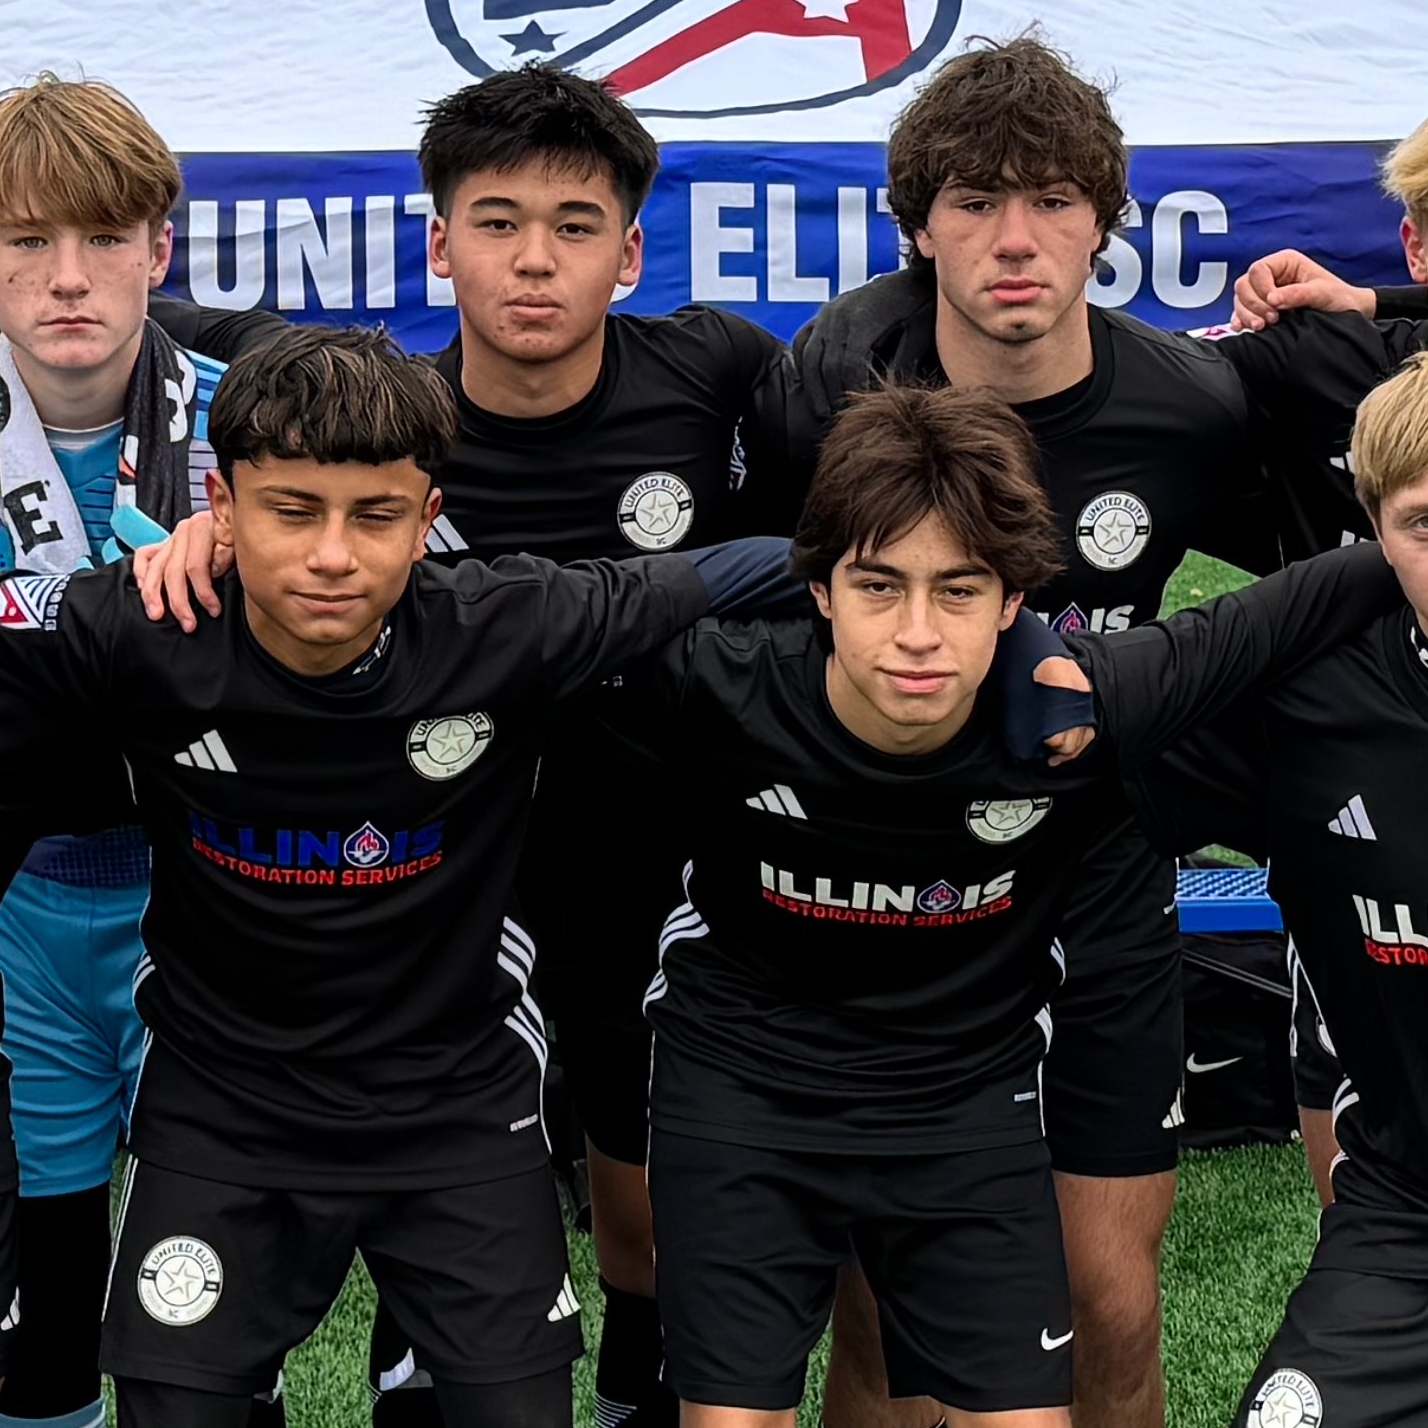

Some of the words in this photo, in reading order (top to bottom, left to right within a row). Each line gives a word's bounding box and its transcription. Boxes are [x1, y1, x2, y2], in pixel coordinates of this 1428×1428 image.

[192, 836, 335, 885] RESTORATION
[341, 850, 444, 886] SERVICES
[762, 889, 907, 926] RESTORATION
[913, 896, 1012, 926] SERVICES
